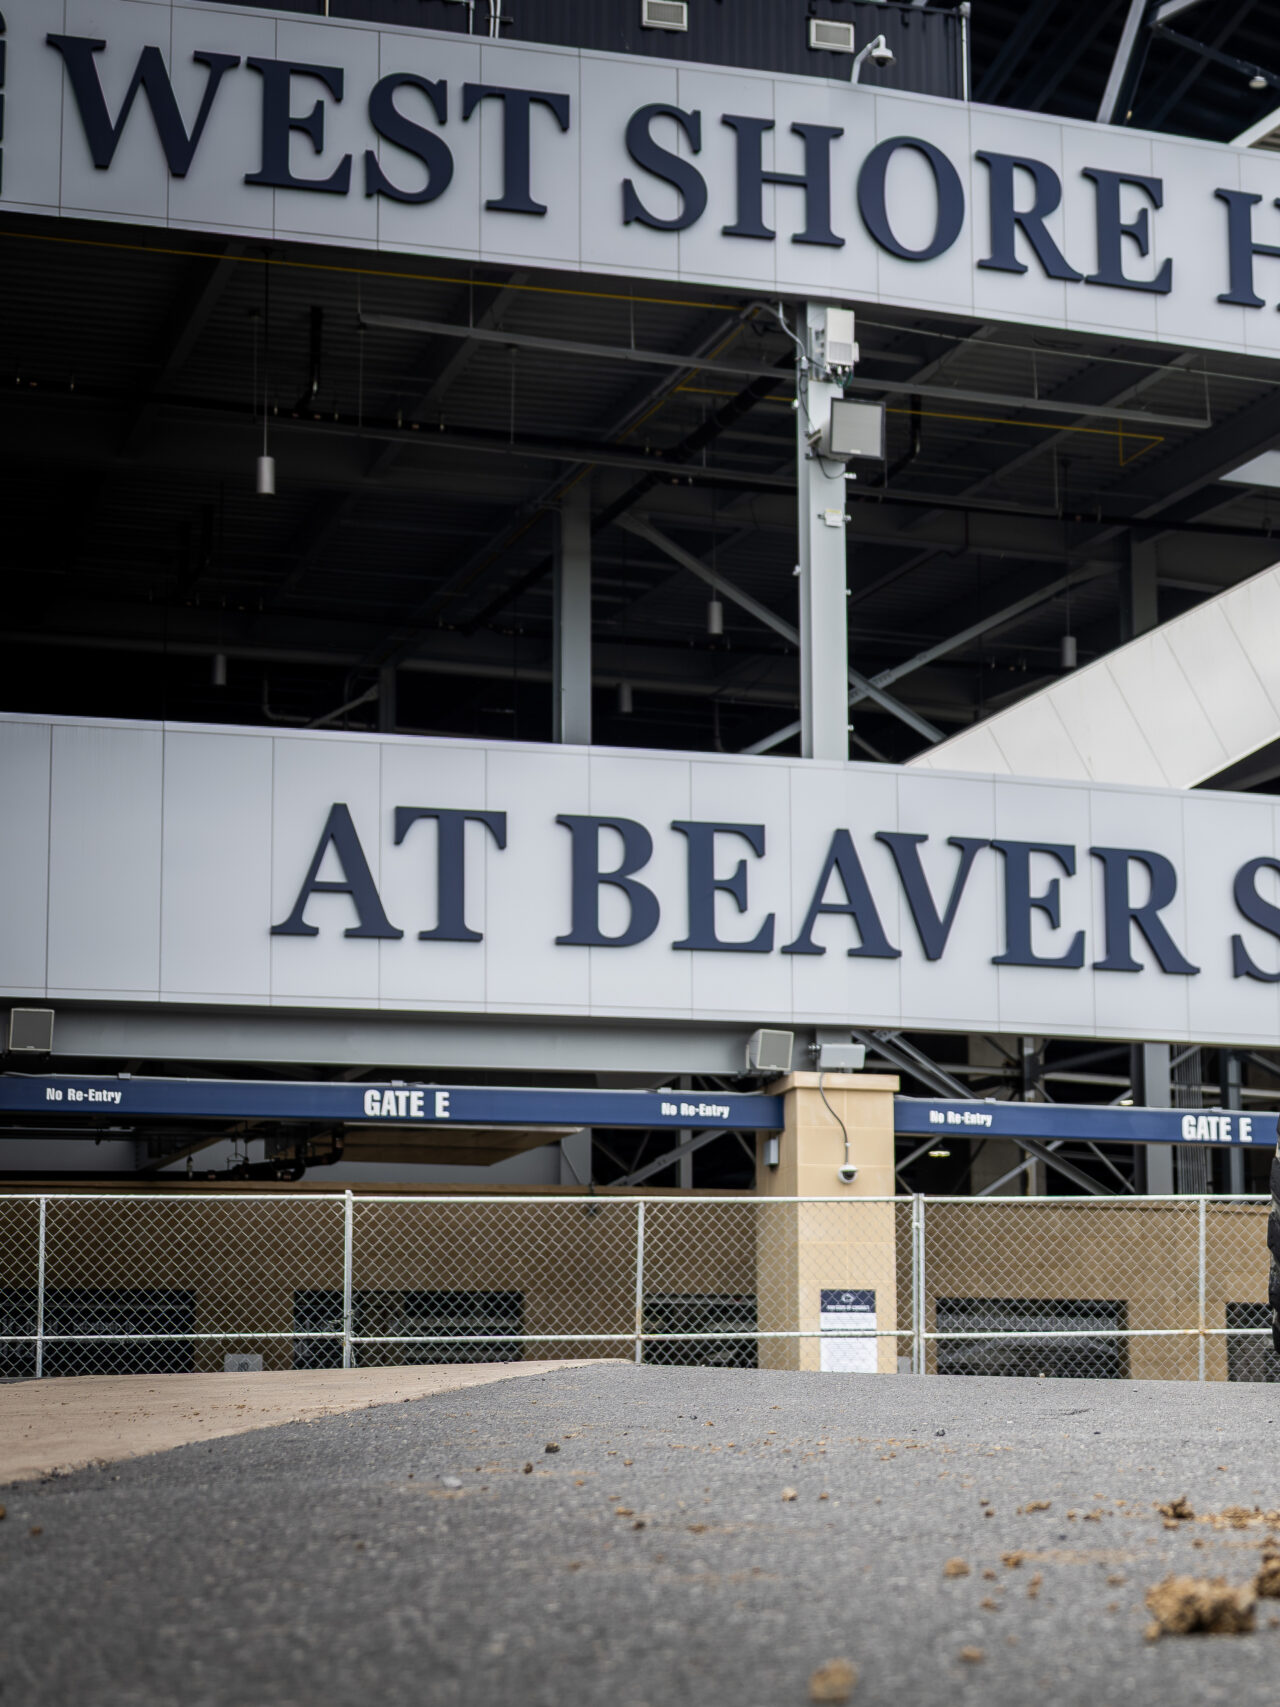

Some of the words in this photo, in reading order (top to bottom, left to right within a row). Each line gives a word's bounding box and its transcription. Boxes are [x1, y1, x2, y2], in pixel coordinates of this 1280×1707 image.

[46, 32, 571, 217] WEST
[622, 102, 1173, 295] SHORE
[269, 802, 508, 943] AT
[554, 813, 1201, 976] BEAVER
[46, 1087, 62, 1101] No
[67, 1088, 122, 1105] Re-Entry
[364, 1089, 425, 1117] GATE
[435, 1091, 450, 1118] E
[661, 1102, 678, 1116] No
[680, 1102, 730, 1119] Re-Entry
[929, 1110, 945, 1124] No
[946, 1111, 993, 1128] Re-Entry
[1181, 1114, 1232, 1142] GATE
[1239, 1117, 1253, 1143] E
